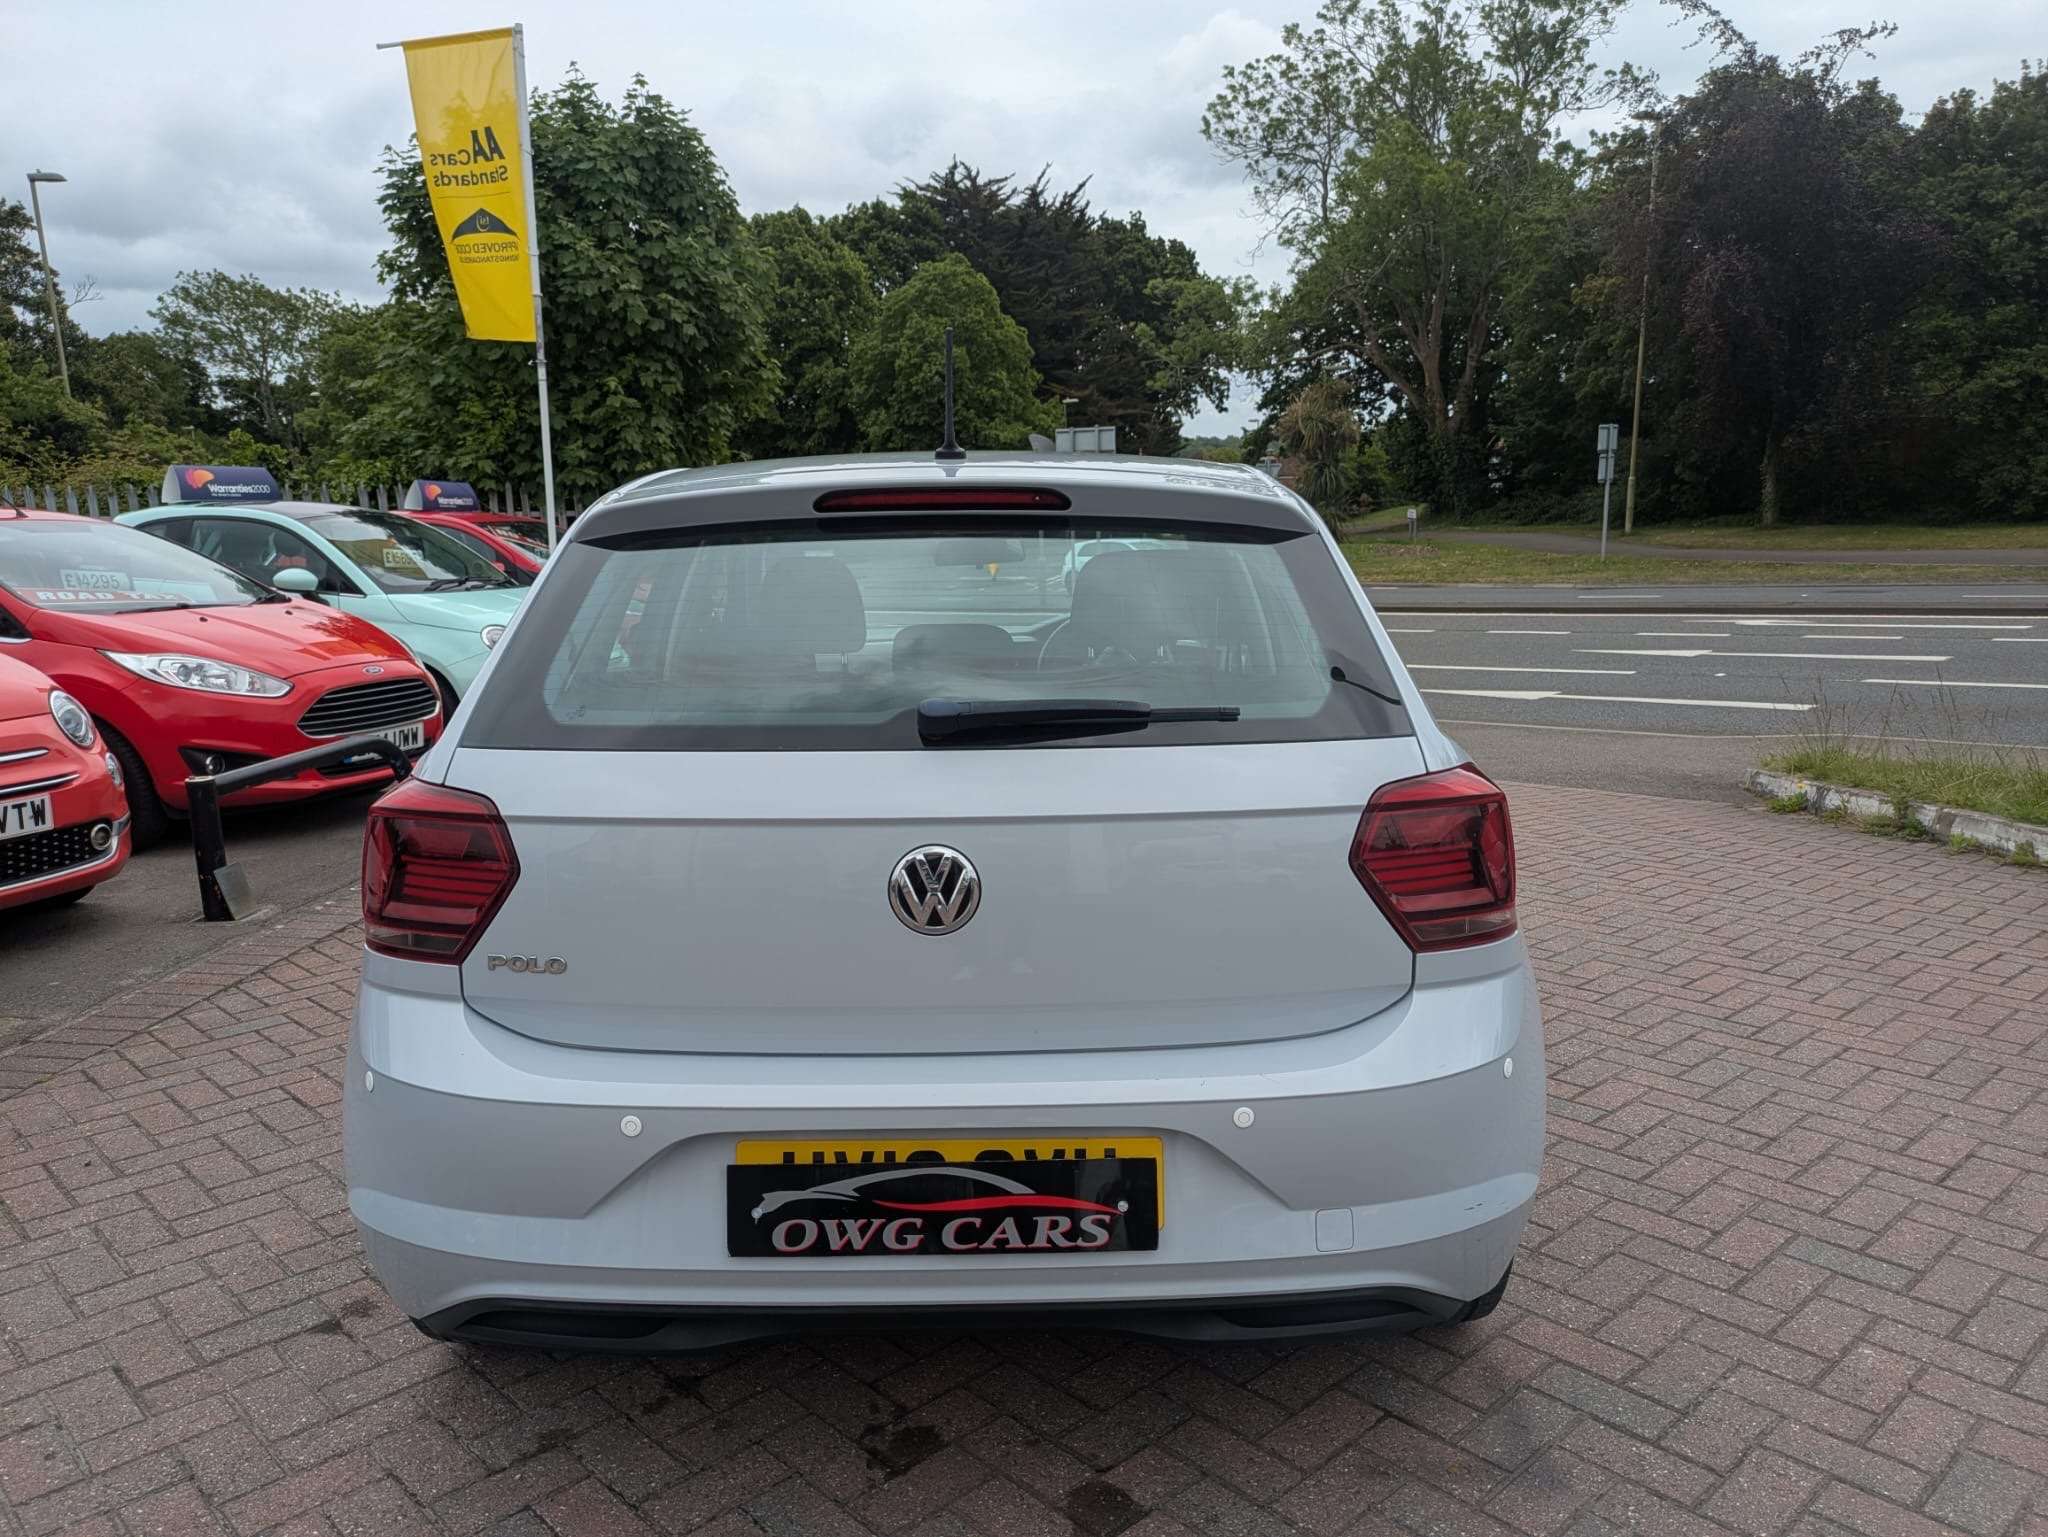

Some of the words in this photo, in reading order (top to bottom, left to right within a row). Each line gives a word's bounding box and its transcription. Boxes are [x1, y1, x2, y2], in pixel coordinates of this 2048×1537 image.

[36, 590, 115, 601] ROAD
[487, 953, 568, 975] POLO
[771, 1217, 928, 1253] OWG
[941, 1214, 1113, 1250] CARS
